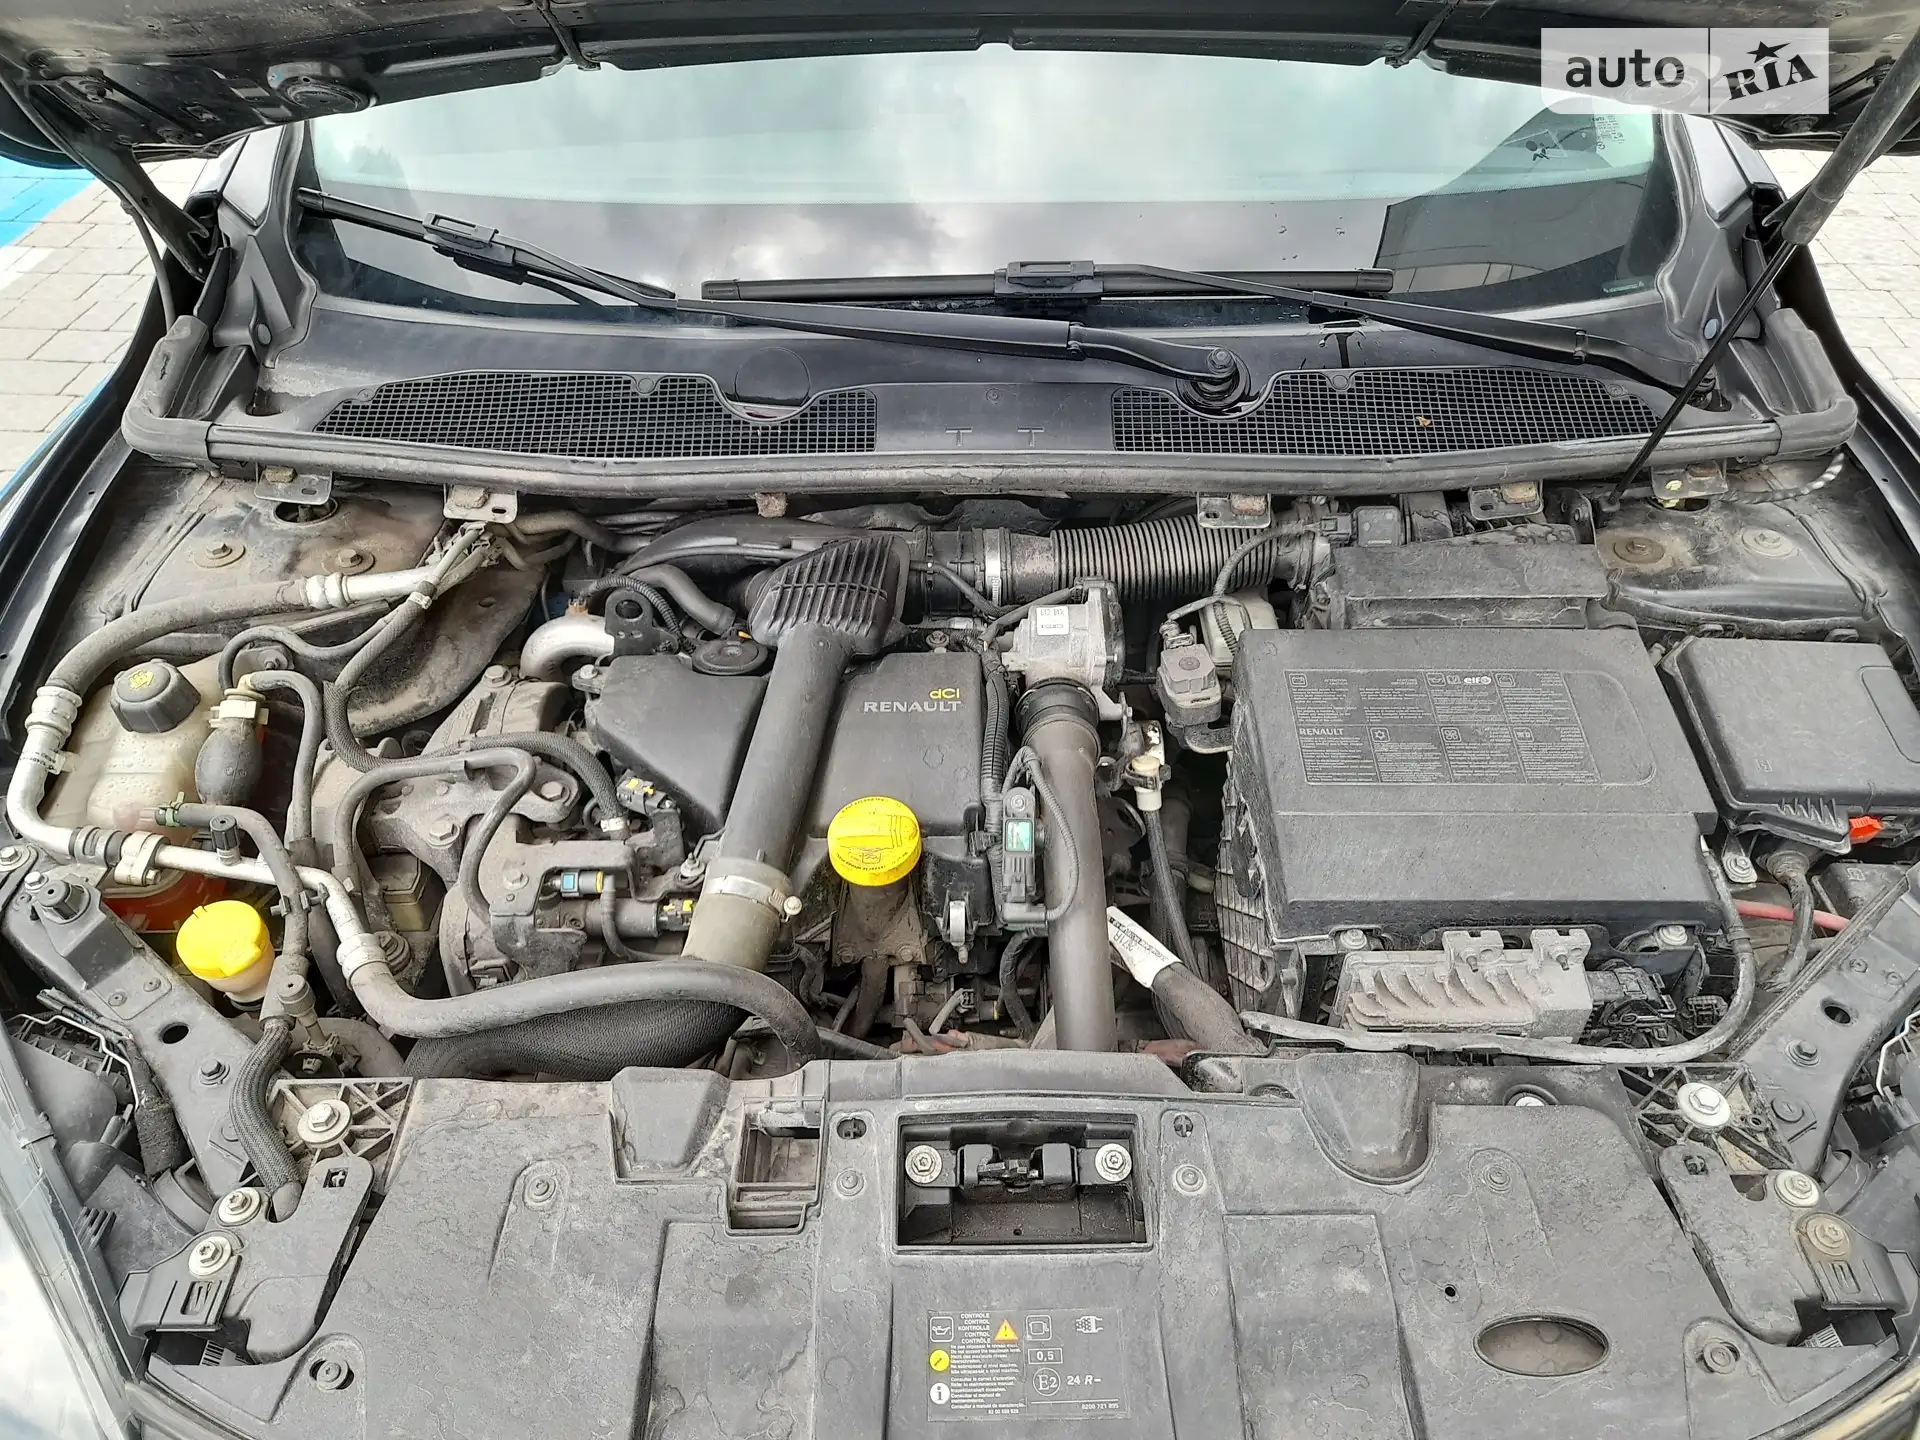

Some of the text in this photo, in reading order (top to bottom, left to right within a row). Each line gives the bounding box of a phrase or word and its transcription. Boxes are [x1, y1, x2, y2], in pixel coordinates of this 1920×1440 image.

[863, 700, 962, 713] RENAULT
[1299, 727, 1344, 736] RENAULT
[1036, 1351, 1054, 1362] 0,5
[1037, 1374, 1058, 1390] E2
[1066, 1375, 1081, 1385] 24
